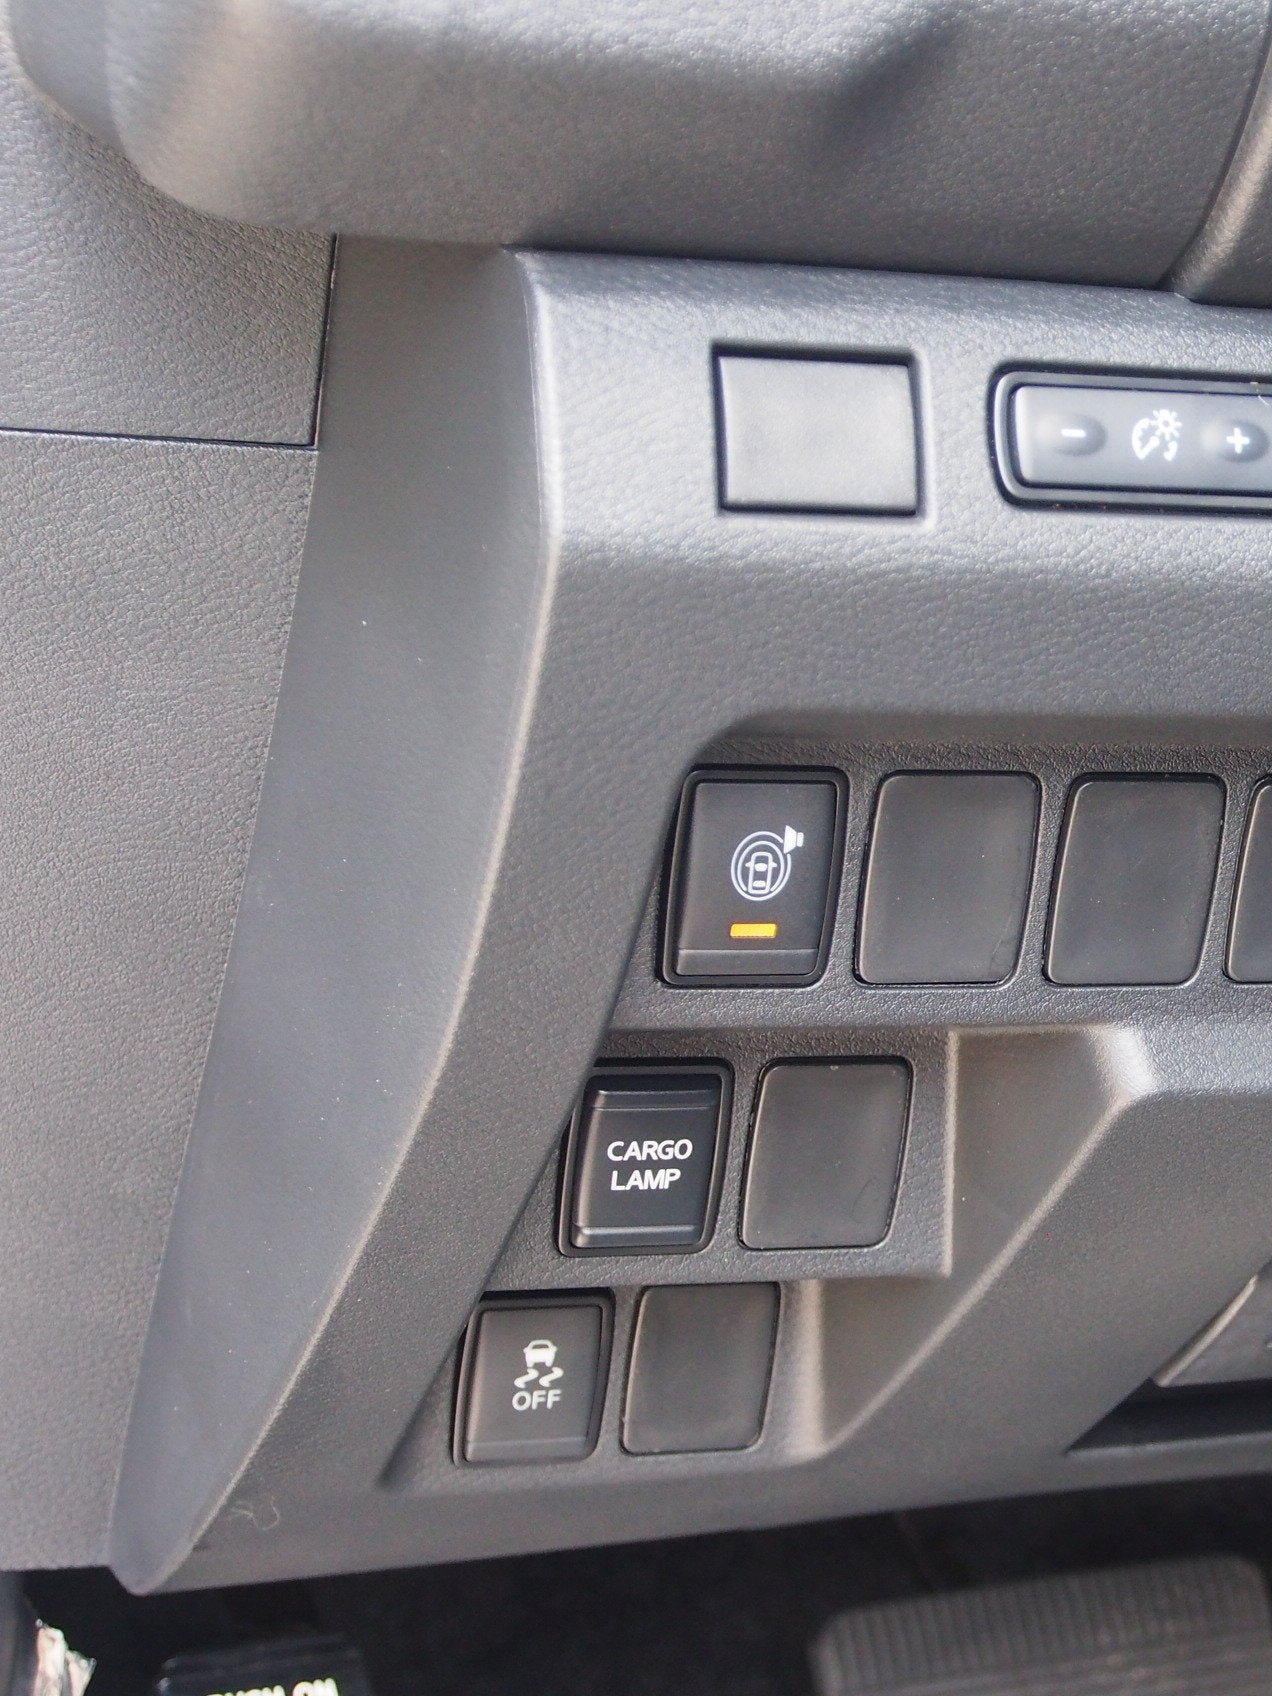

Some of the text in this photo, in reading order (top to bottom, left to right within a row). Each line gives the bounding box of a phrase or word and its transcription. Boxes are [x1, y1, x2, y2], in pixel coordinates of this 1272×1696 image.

[606, 1138, 694, 1162] CARGO
[610, 1168, 682, 1191] LAMP
[511, 1389, 562, 1411] OFF
